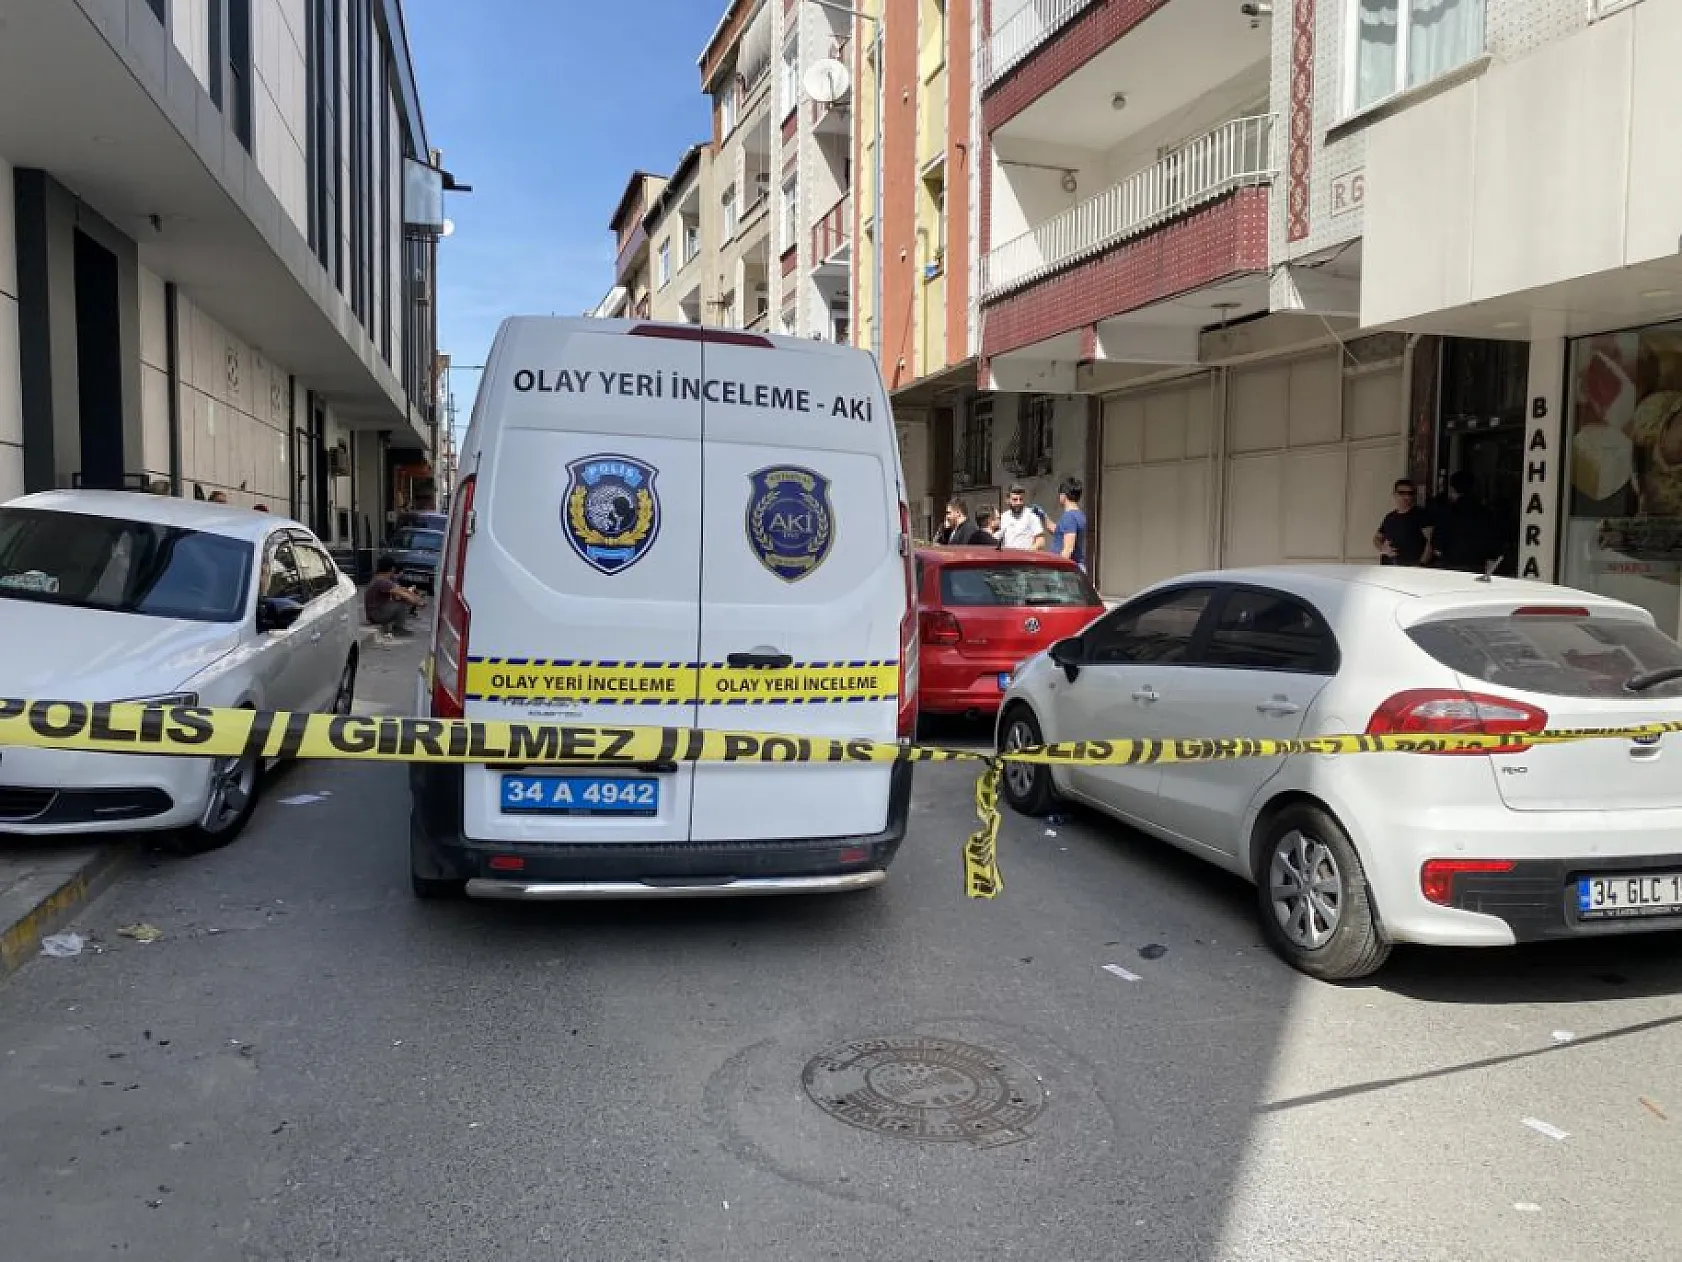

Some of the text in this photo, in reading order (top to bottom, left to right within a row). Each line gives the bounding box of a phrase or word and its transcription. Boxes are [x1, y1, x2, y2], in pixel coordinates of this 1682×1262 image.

[513, 368, 592, 393] OLAY
[599, 370, 662, 398] YERİ
[672, 371, 811, 413] İNCELEME
[831, 395, 873, 423] AKİ
[768, 511, 814, 533] AKİ
[491, 673, 676, 694] OLAY YERİ İNCELEME
[716, 674, 878, 693] OLAY YERİ İNCELEME
[328, 716, 635, 761] GİRİLMEZ
[507, 781, 655, 804] 34 A 4942
[1594, 880, 1617, 906] 34
[1628, 877, 1661, 904] GLC
